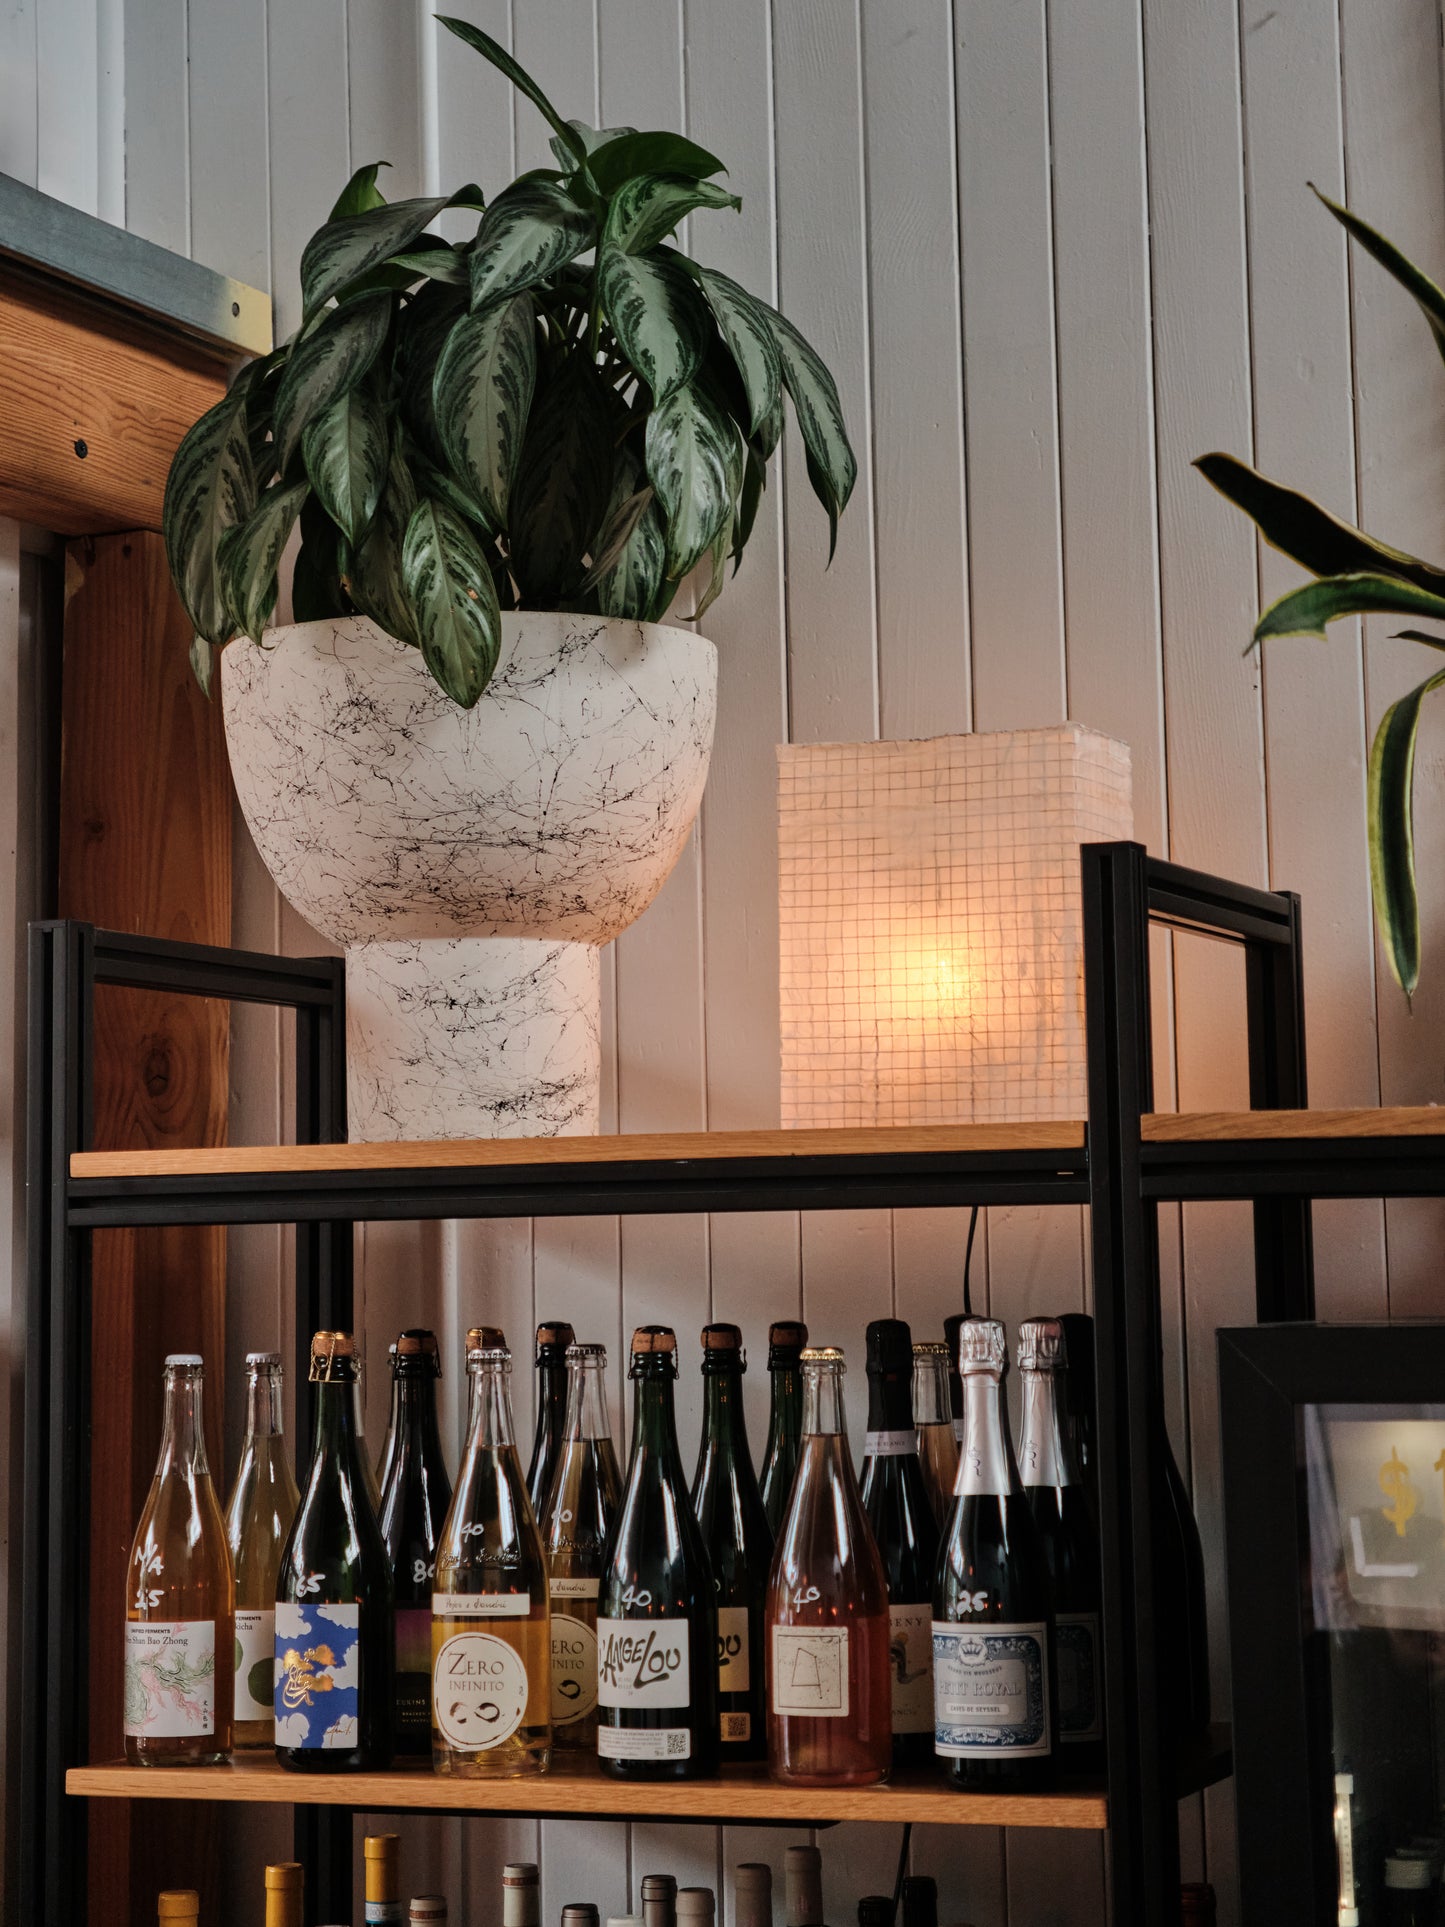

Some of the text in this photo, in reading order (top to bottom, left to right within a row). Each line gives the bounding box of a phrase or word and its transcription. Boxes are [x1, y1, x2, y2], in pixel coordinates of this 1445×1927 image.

[461, 1521, 484, 1543] 40
[296, 1573, 326, 1598] 65
[621, 1585, 652, 1611] 40
[793, 1587, 821, 1613] 40
[147, 1636, 161, 1645] Bao
[162, 1636, 189, 1647] Zhong
[551, 1641, 585, 1654] ERO
[448, 1653, 504, 1675] ZERO
[449, 1681, 504, 1691] INFINITO
[973, 1682, 1022, 1697] ROYAL
